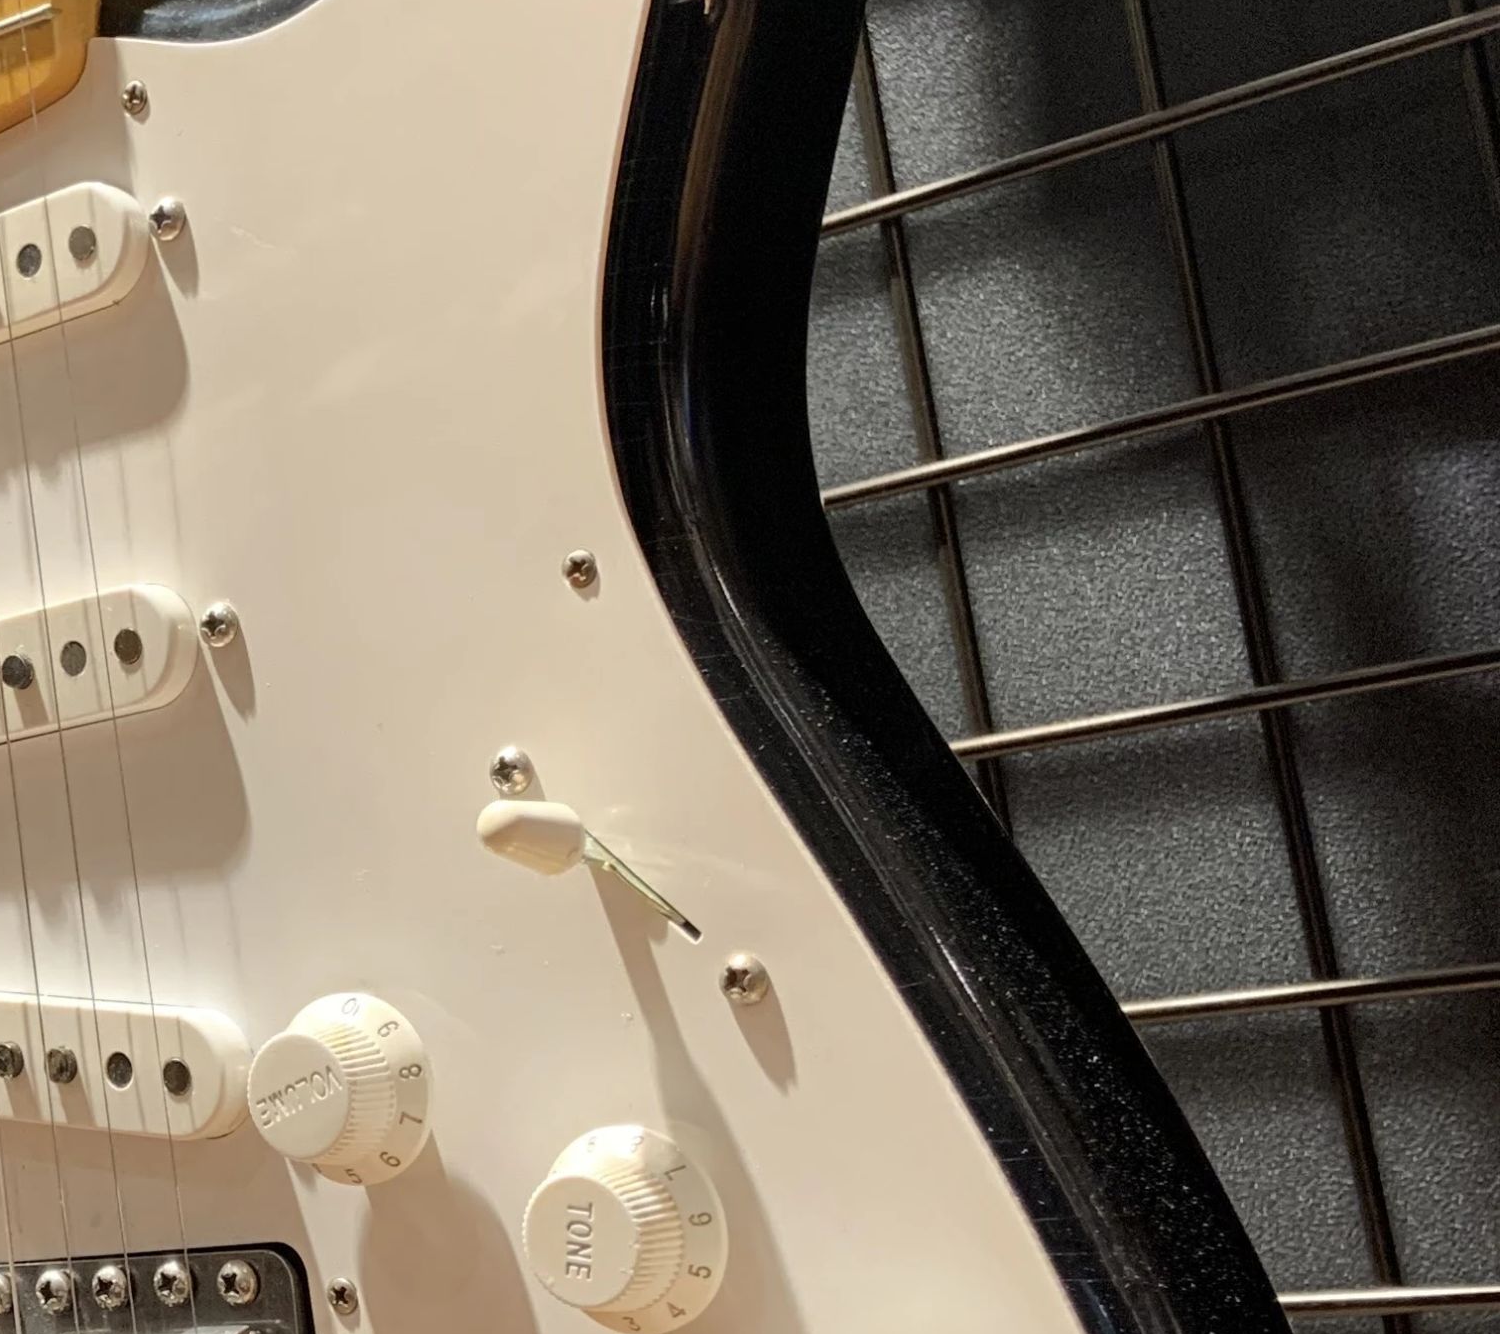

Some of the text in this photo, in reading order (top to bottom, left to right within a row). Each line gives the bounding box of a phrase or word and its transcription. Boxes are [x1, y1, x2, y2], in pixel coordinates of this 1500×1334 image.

[399, 1063, 422, 1080] 8
[256, 1064, 343, 1130] VOLUME
[399, 1111, 423, 1126] 7
[379, 1151, 402, 1168] 6
[344, 1168, 363, 1185] 5
[663, 1164, 687, 1182] 7
[688, 1212, 713, 1227] 6
[565, 1202, 593, 1281] TONE
[687, 1263, 713, 1280] 5
[666, 1301, 687, 1319] 4
[622, 1316, 641, 1332] 3
